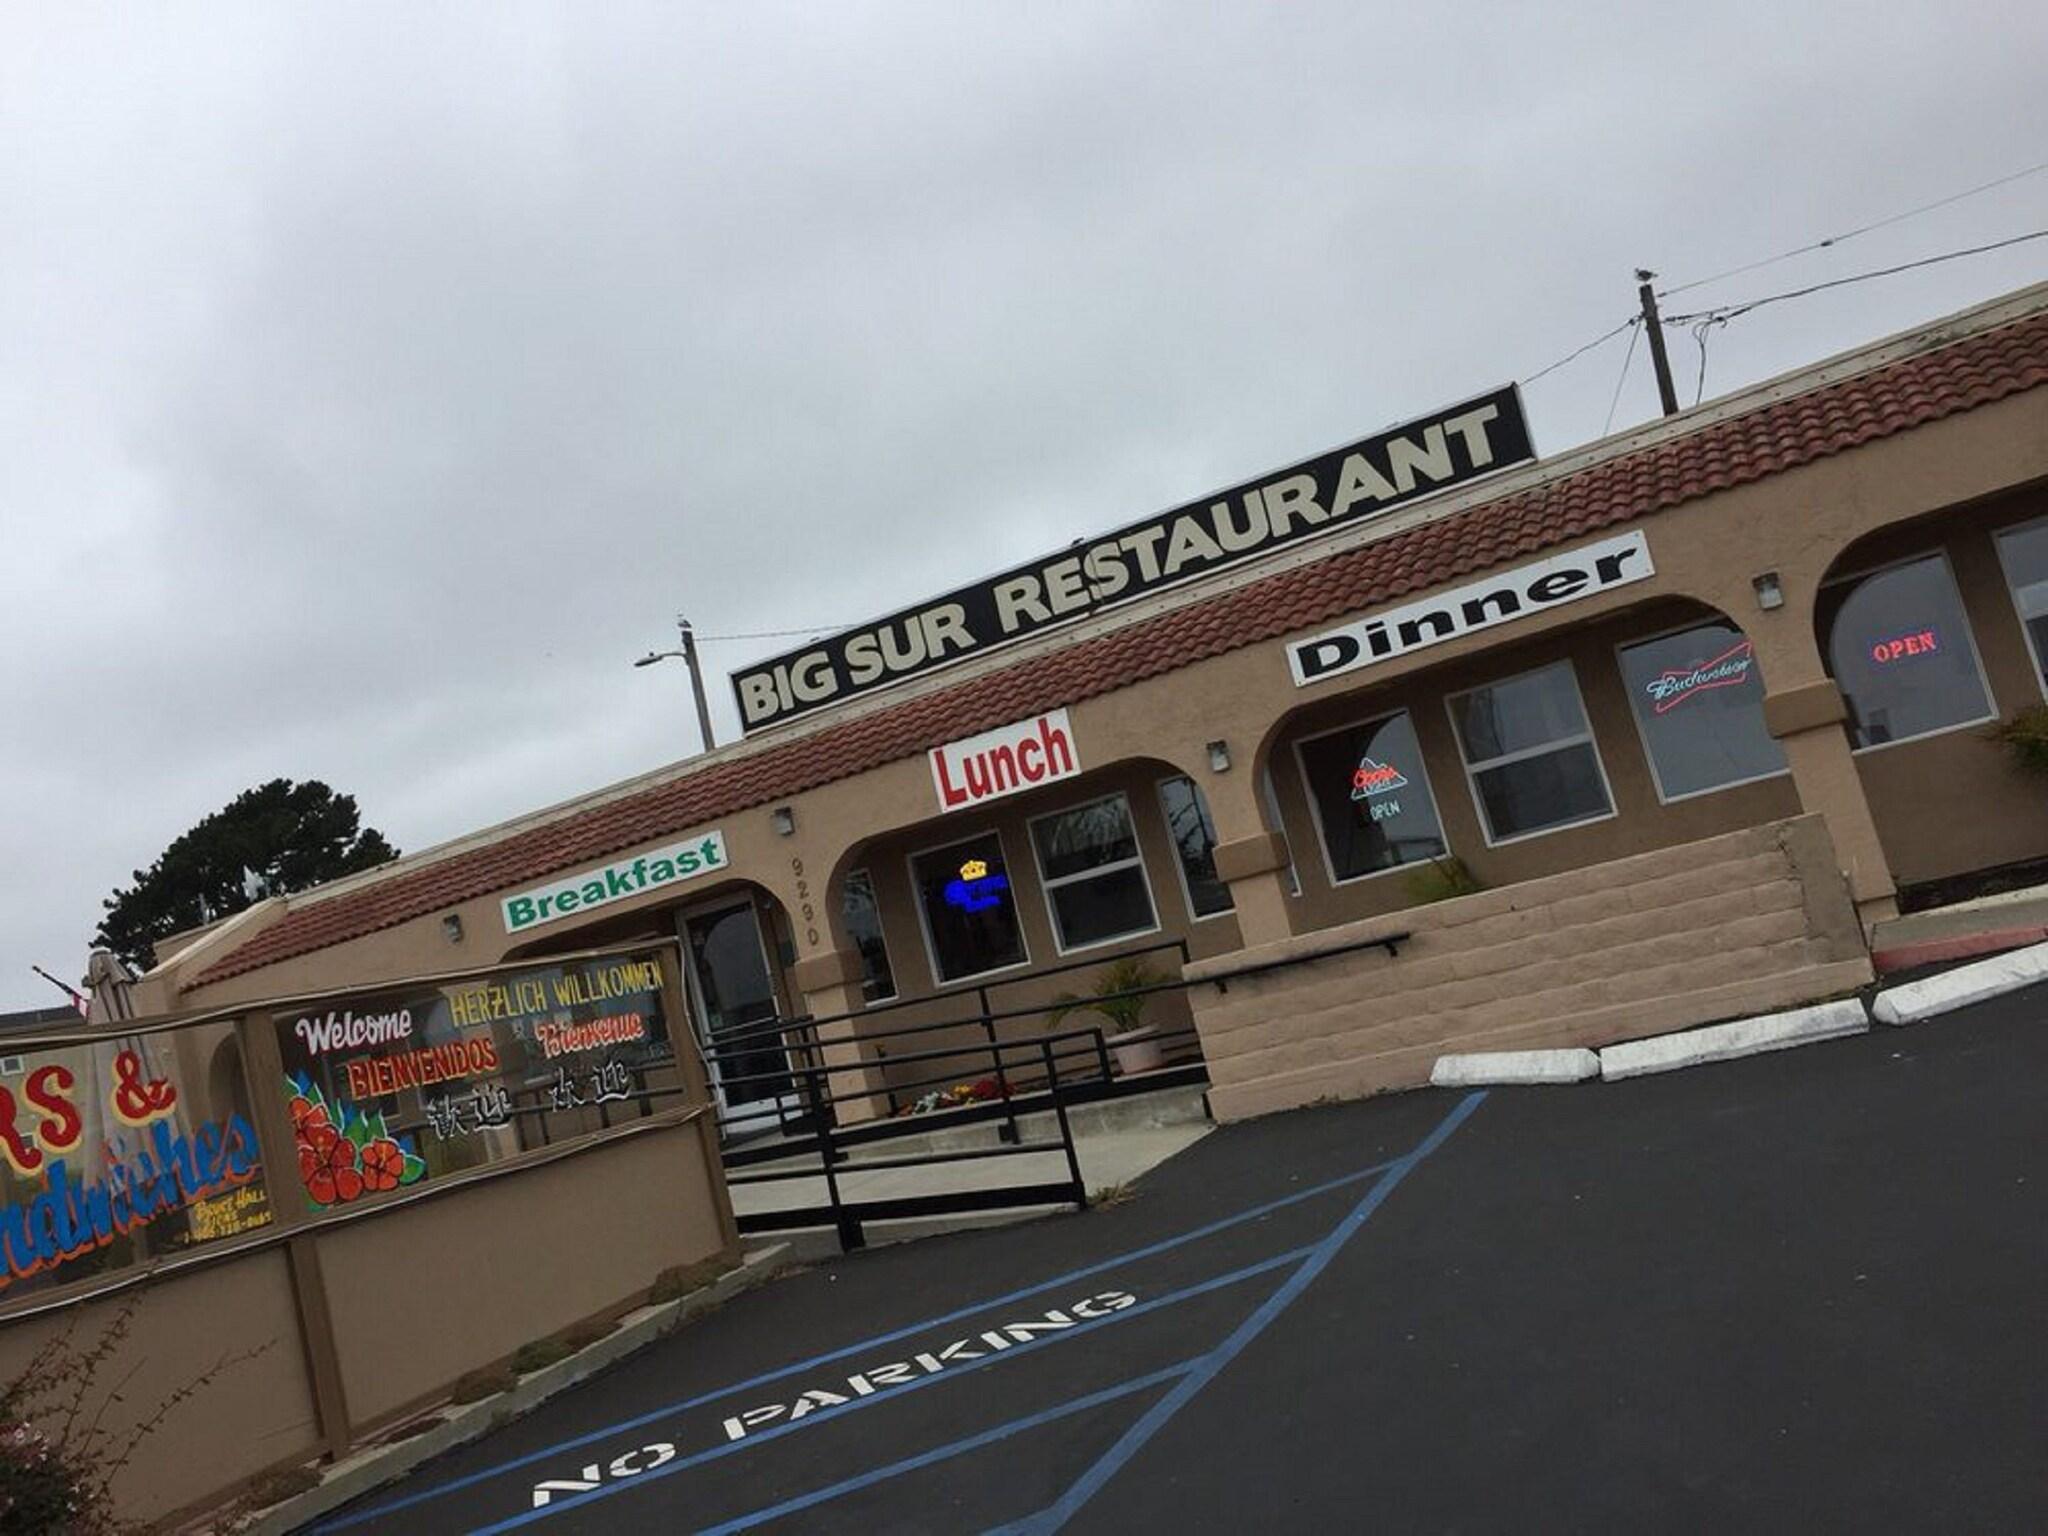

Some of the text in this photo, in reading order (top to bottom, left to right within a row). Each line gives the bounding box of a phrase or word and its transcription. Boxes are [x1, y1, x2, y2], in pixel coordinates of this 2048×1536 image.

[739, 404, 1499, 724] BIG SUR RESTAURANT
[1295, 545, 1643, 678] Dinner
[1873, 631, 1936, 662] OPEN
[934, 718, 1073, 808] Lunch
[1370, 800, 1400, 820] OPEN
[507, 837, 722, 930] Breakfast
[451, 961, 664, 1027] HERZLICH WILLKOMMEN
[295, 1008, 413, 1055] Welcome
[534, 1012, 646, 1059] Bienvenue
[112, 1050, 177, 1126] &
[347, 1037, 497, 1099] BIENVENIDOS
[532, 1290, 1138, 1508] NO PARKING
